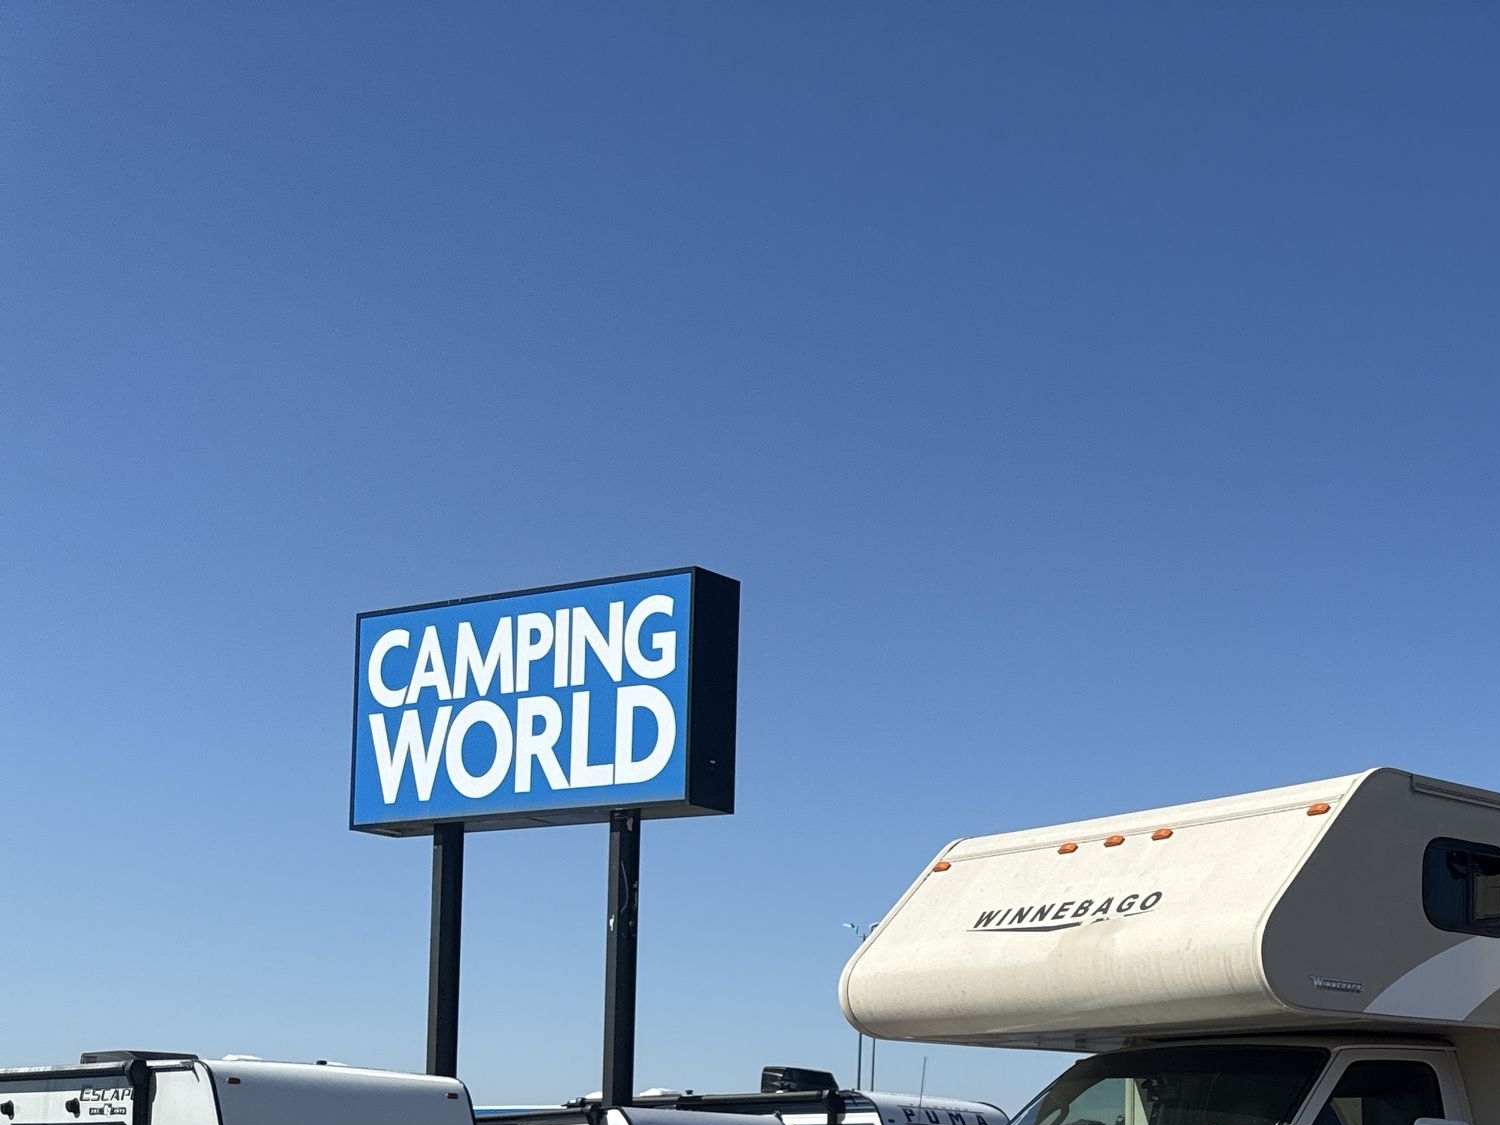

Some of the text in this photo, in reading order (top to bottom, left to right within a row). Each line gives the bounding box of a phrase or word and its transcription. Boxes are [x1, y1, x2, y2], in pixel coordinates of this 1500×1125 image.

[367, 594, 677, 708] CAMPING
[368, 684, 677, 805] WORLD
[973, 891, 1162, 928] WINNEBAGO
